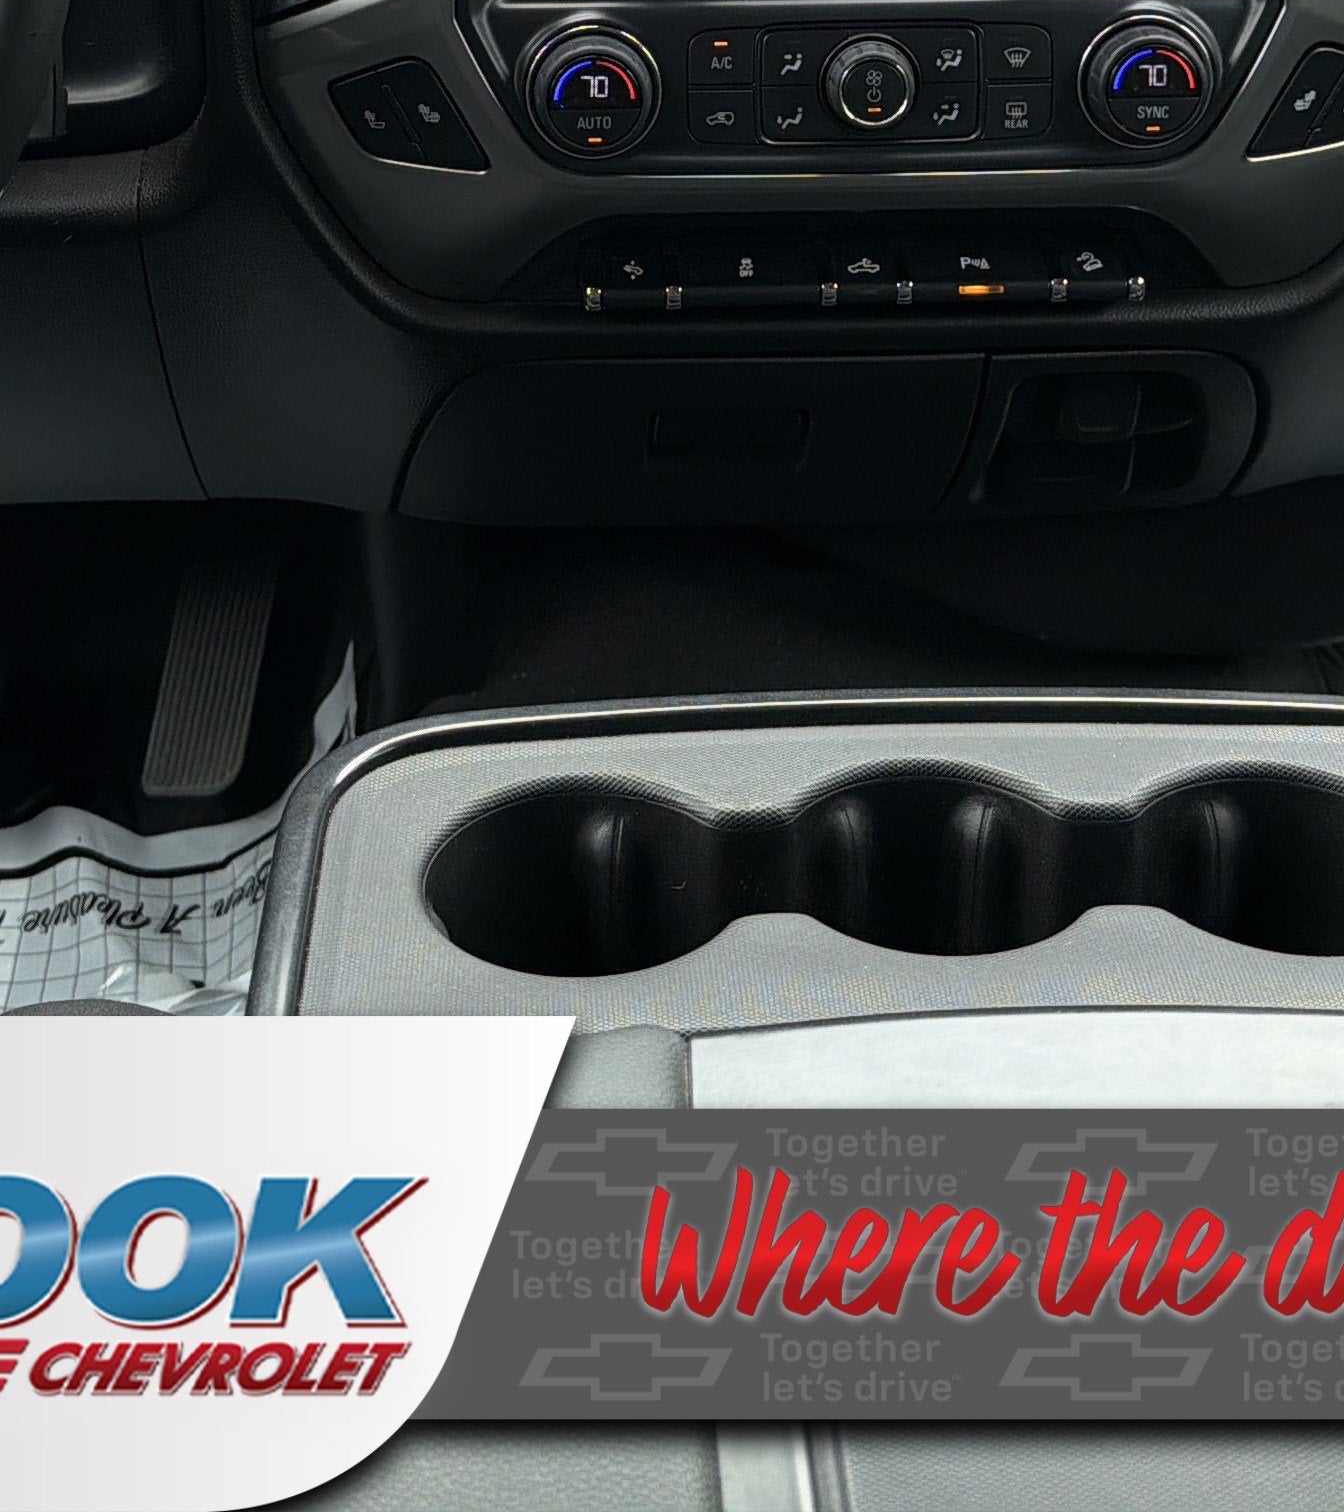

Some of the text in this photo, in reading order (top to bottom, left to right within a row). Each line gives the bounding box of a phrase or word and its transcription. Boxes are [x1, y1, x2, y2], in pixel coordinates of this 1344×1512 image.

[710, 56, 733, 70] A/C
[1138, 64, 1168, 87] 70
[580, 75, 609, 99] 70
[1136, 105, 1170, 120] SYNC
[576, 116, 612, 130] AUTO
[1004, 119, 1029, 129] REAR
[22, 891, 151, 934] Pleasure
[159, 904, 201, 935] A
